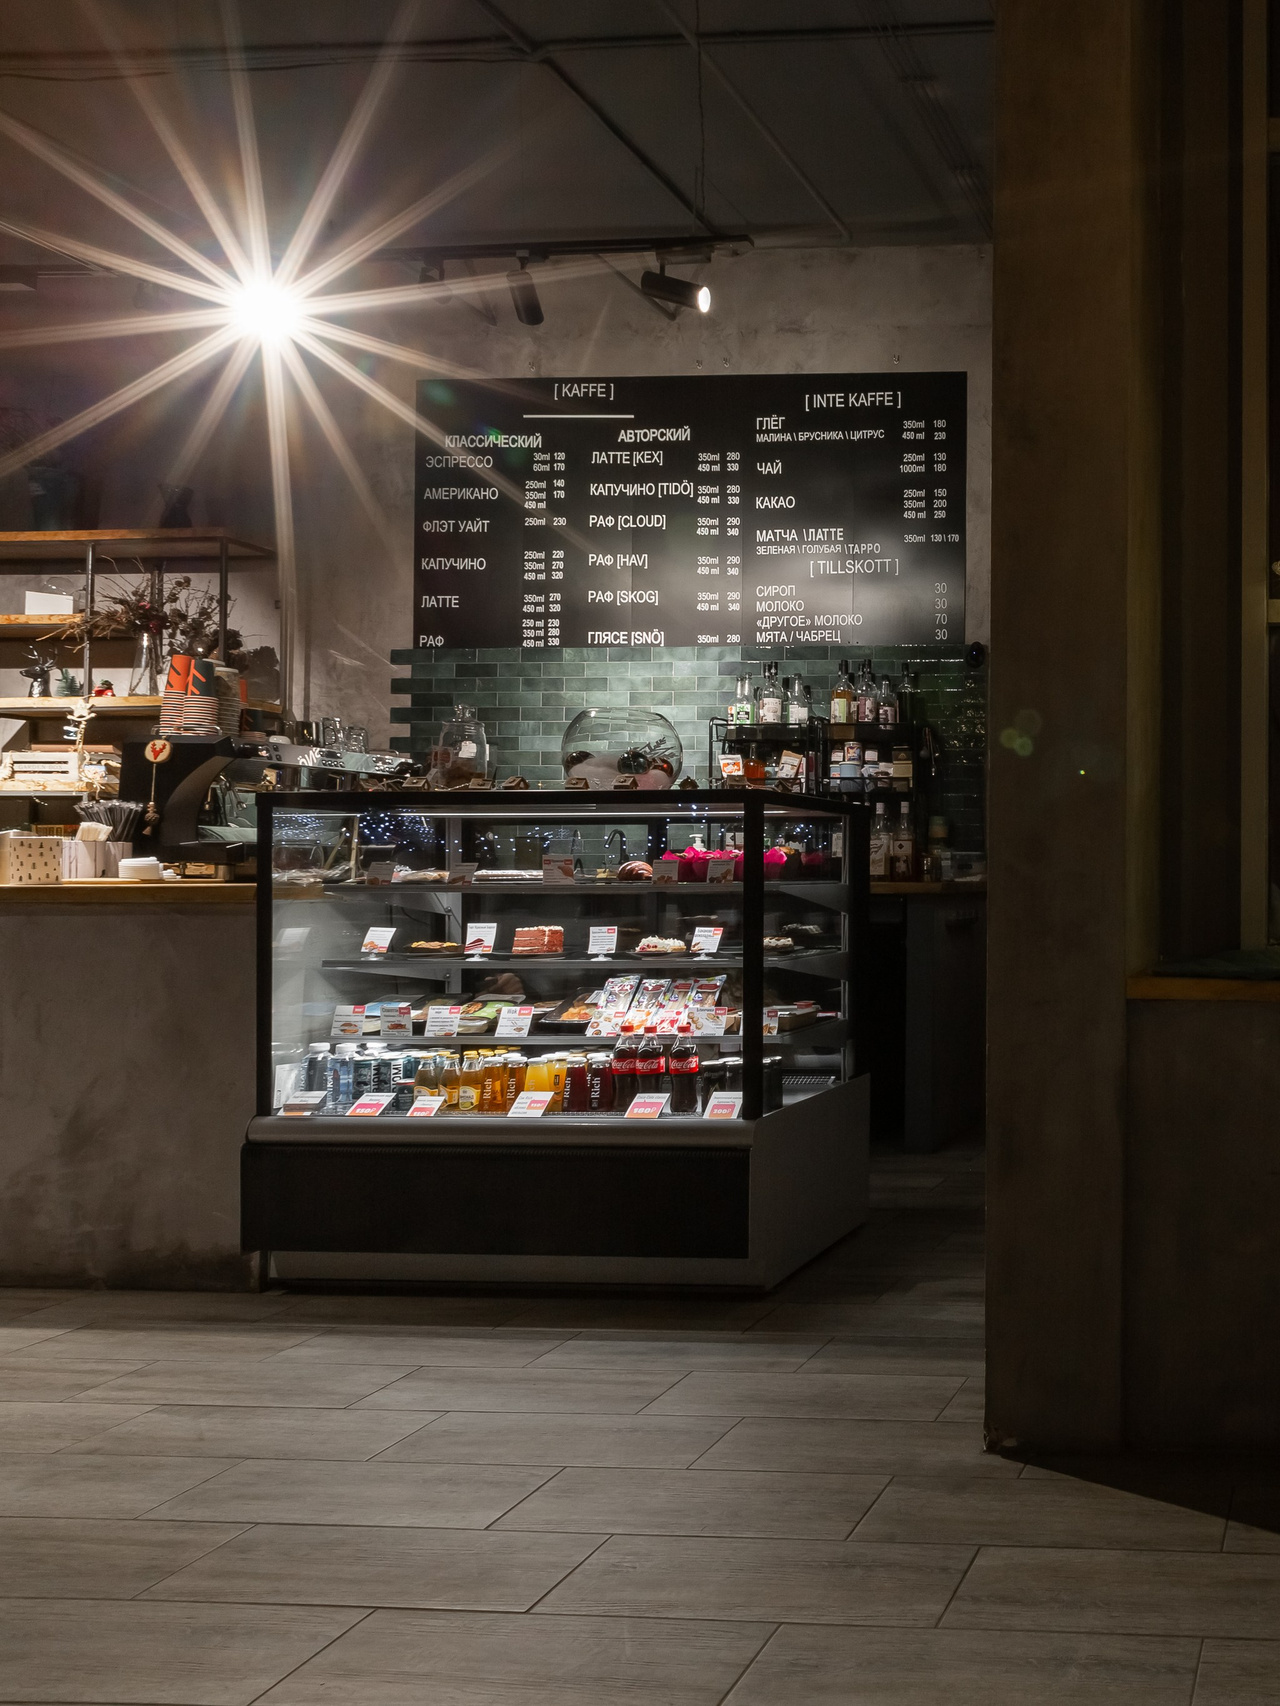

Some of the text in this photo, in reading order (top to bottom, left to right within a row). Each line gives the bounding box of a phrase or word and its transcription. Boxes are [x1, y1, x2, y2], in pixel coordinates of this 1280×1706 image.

[757, 415, 785, 430] ГЛЁГ
[903, 420, 946, 429] 350ml 180
[618, 426, 690, 442] АВТОРСКИЙ
[756, 430, 884, 442] МАЛИНА БРУСНИКА ЦИТРУС
[934, 432, 946, 440] 230
[446, 433, 542, 448] КЛАССИЧЕСКИЙ
[554, 452, 565, 460] 120
[592, 452, 630, 463] ЛАТТЕ
[698, 452, 740, 461] 350ml 280
[903, 453, 946, 462] 250ml 130
[426, 456, 493, 468] ЭСПРЕССО
[533, 463, 550, 471] 60ml
[727, 463, 739, 471] 330
[757, 460, 781, 474] ЧАЙ
[900, 464, 925, 472] 1000ml
[525, 479, 564, 489] 250ml 140
[424, 488, 498, 499] АМЕРИКАНО
[590, 483, 655, 496] КАПУЧИНО
[698, 485, 740, 494] 350ml 280
[904, 489, 925, 497] 250ml
[525, 491, 546, 499] 350ml
[728, 496, 739, 504] 330
[756, 496, 795, 509] КАКАО
[904, 499, 947, 508] 350ml 200
[934, 510, 946, 518] 250
[423, 518, 490, 532] ФЛЭТ УАЙТ
[553, 517, 566, 525] 230
[590, 515, 614, 527] РАФ
[697, 517, 740, 526] 350ml 290
[727, 528, 739, 536] 340
[757, 529, 798, 542] МАТЧА
[756, 545, 795, 555] ЗЕЛЕНАЯ
[802, 544, 841, 553] ГОЛУБАЯ
[524, 551, 545, 559] 250ml
[589, 554, 613, 566] РАФ
[698, 556, 740, 564] 350ml 290
[422, 558, 486, 570] КАПУЧИНО
[524, 561, 564, 570] 350ml 270
[552, 571, 563, 579] 320
[727, 567, 739, 575] 340
[756, 585, 795, 597] СИРОП
[935, 583, 947, 593] 30
[549, 593, 561, 601] 270
[588, 591, 613, 602] РАФ
[697, 592, 740, 600] 350ml 290
[421, 596, 459, 607] ЛАТТЕ
[757, 600, 804, 612] МОЛОКО
[935, 598, 947, 609] 30
[549, 604, 561, 612] 320
[728, 603, 740, 611] 340
[548, 619, 559, 627] 230
[815, 614, 862, 626] МОЛОКО
[935, 614, 947, 624] 70
[548, 628, 559, 636] 280
[757, 630, 840, 643] МЯТА ЧАБРЕЦ
[936, 629, 947, 640] 30
[420, 635, 444, 647] РАФ
[588, 632, 628, 644] ГЛЯСЕ
[697, 635, 740, 643] 350ml 280
[483, 1078, 492, 1099] Rich
[507, 1078, 516, 1099] Rich
[563, 1077, 571, 1098] Rich
[591, 1077, 600, 1098] Rich
